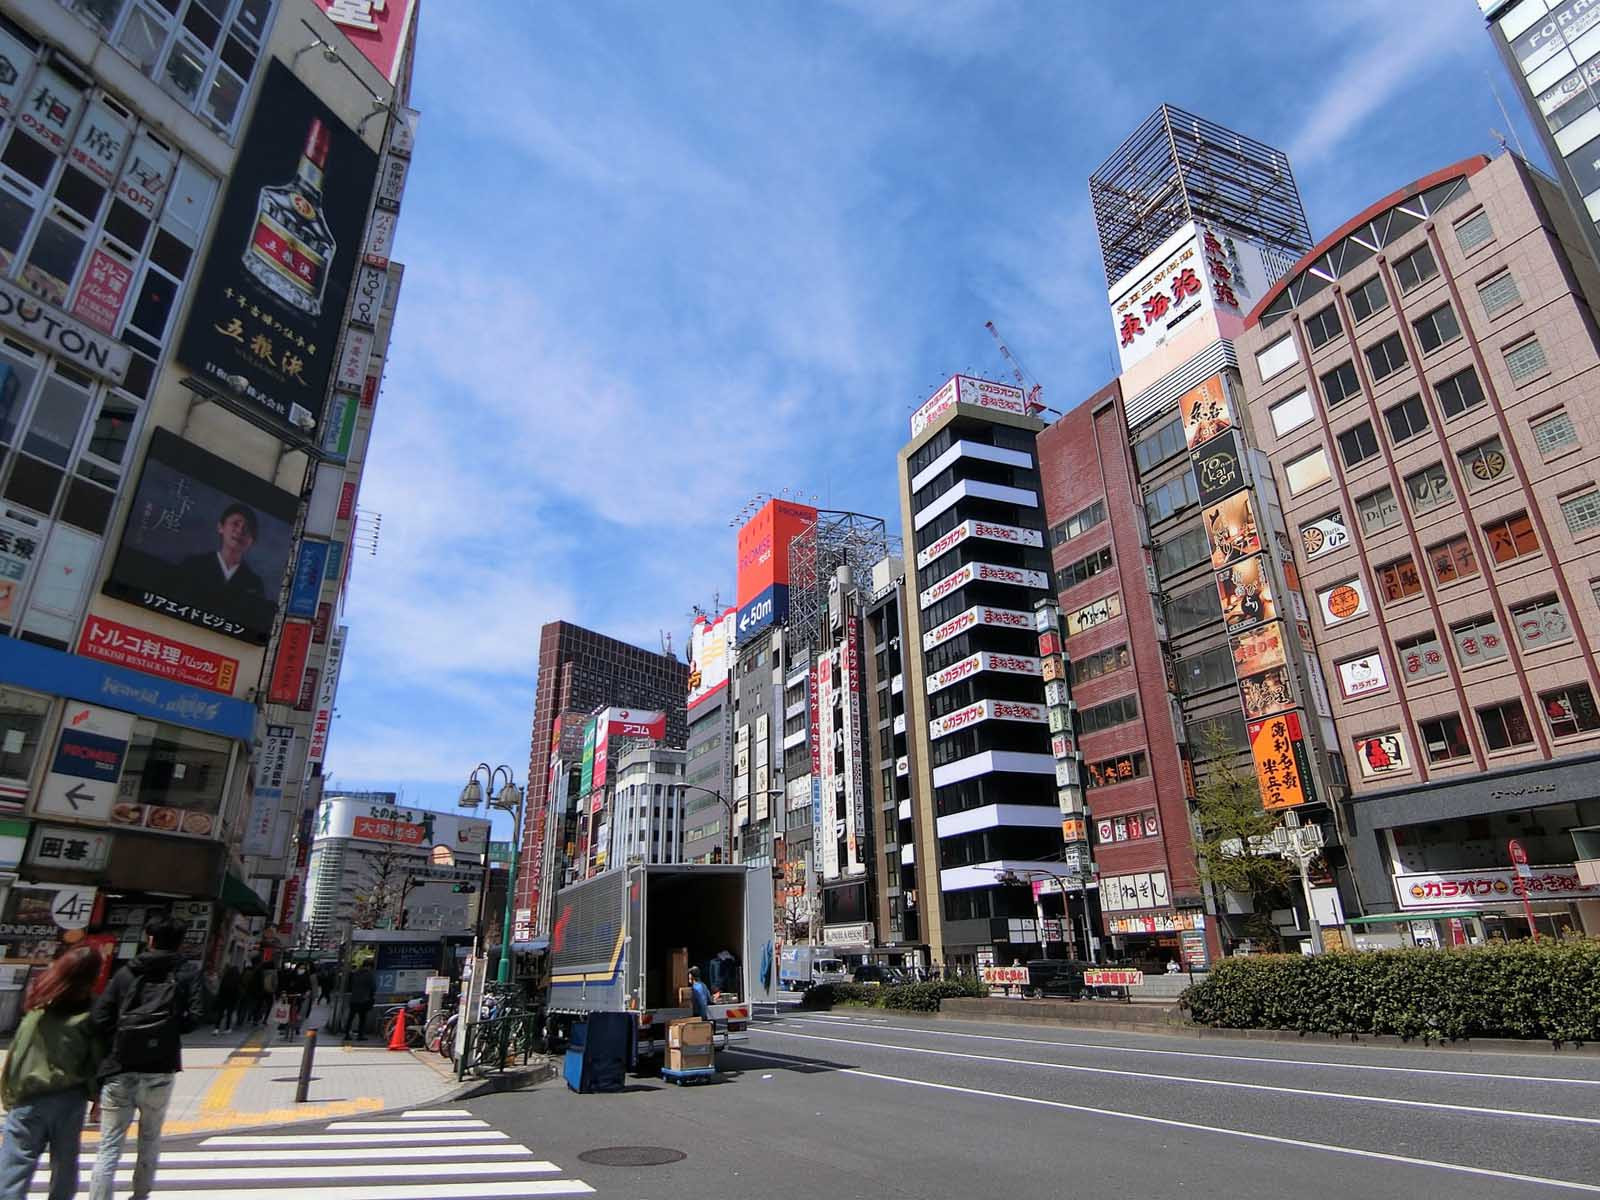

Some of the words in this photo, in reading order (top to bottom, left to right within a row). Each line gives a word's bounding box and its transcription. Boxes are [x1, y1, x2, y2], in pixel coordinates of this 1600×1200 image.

[934, 529, 961, 554] カラオケ
[974, 522, 1019, 542] まねきねこ
[935, 572, 965, 596] カラオケ
[979, 564, 1025, 584] まねきねこ
[750, 597, 773, 627] 50m
[983, 607, 1029, 627] まねきねこ
[940, 616, 969, 637] カラオケ
[89, 622, 182, 665] トルコ料理
[943, 659, 974, 682] カラオケ
[988, 655, 1034, 673] まねきねこ
[1350, 676, 1380, 692] カラオケ
[948, 706, 978, 728] カラオケ
[993, 702, 1040, 721] まねきねこ
[621, 722, 651, 735] アコム
[1423, 879, 1494, 898] カラオケ
[55, 892, 92, 921] 4F
